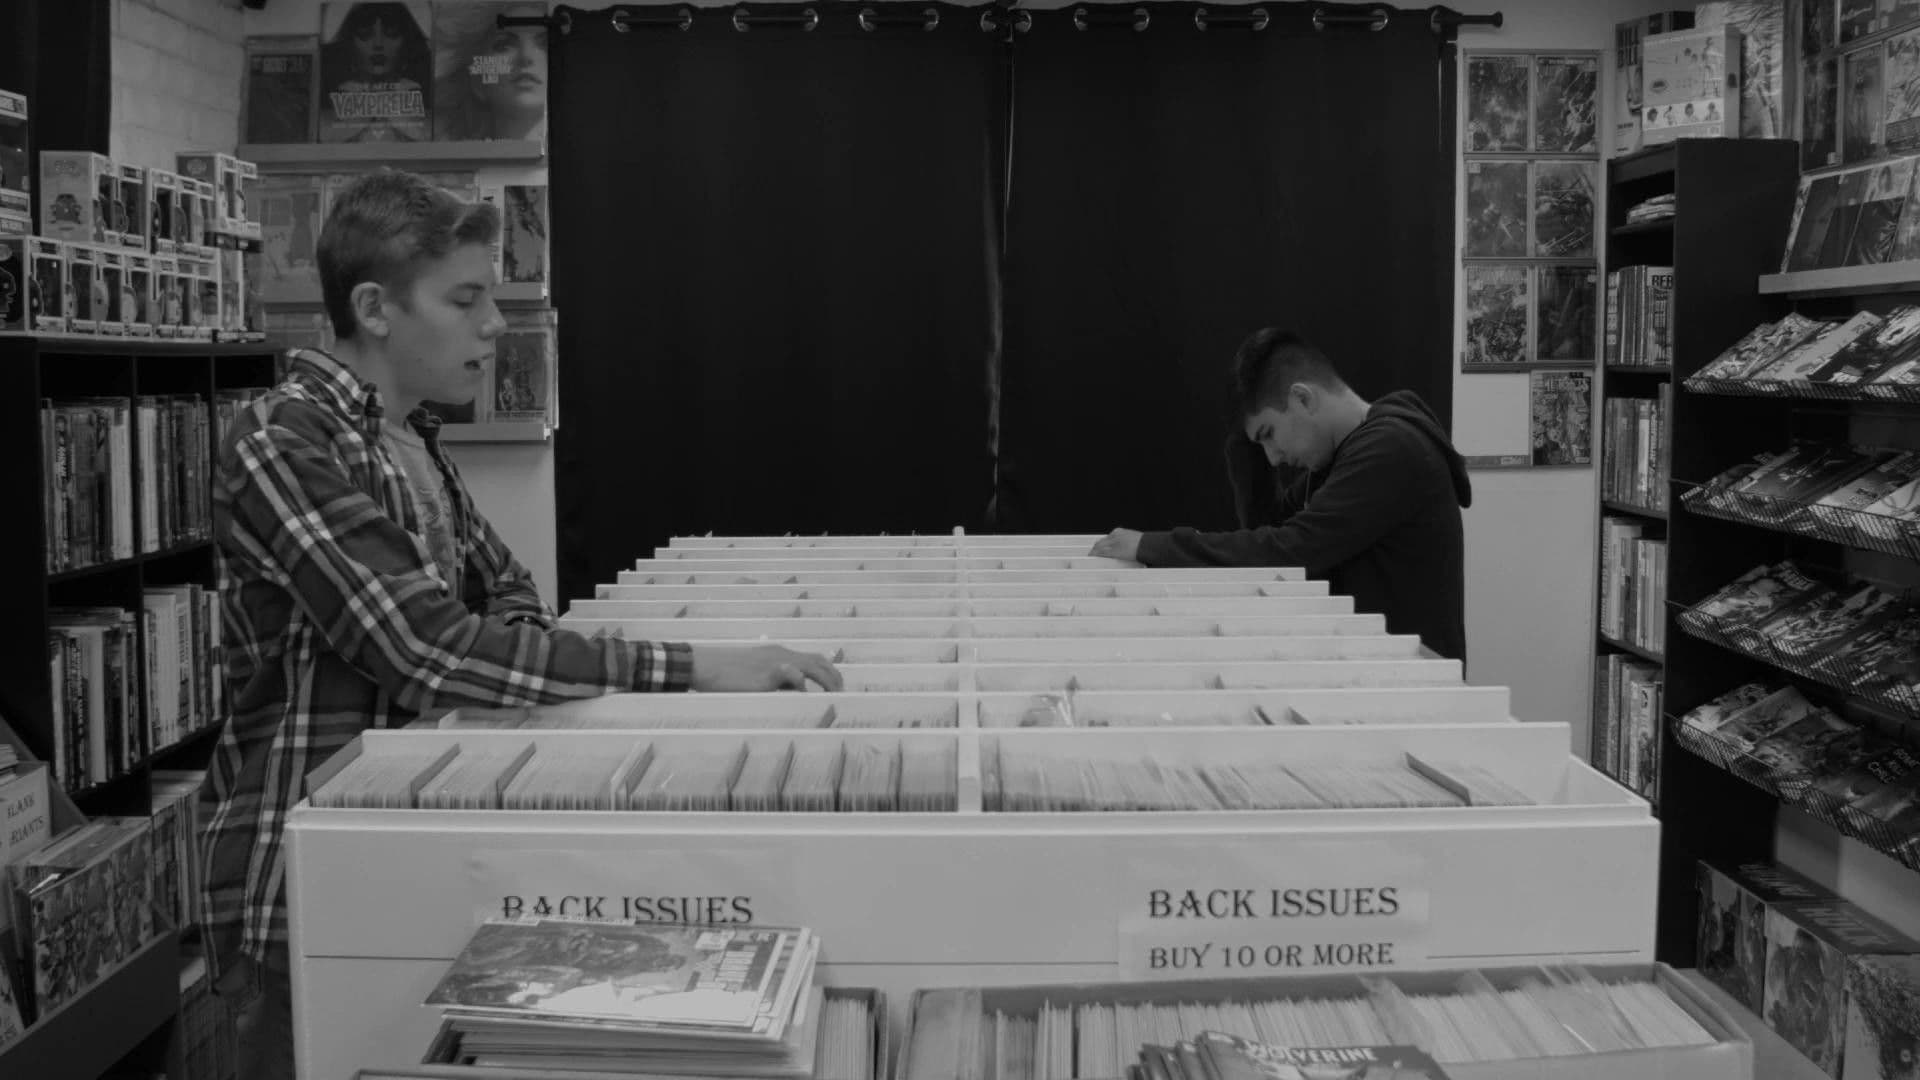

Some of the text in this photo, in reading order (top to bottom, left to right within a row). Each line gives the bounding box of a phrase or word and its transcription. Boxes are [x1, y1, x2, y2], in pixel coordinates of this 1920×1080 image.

[329, 90, 425, 120] VAMPIRELLA
[502, 896, 754, 923] BACK ISSUES
[1148, 887, 1400, 920] BACK ISSUES
[1150, 942, 1395, 969] BUY 10 OR MORE
